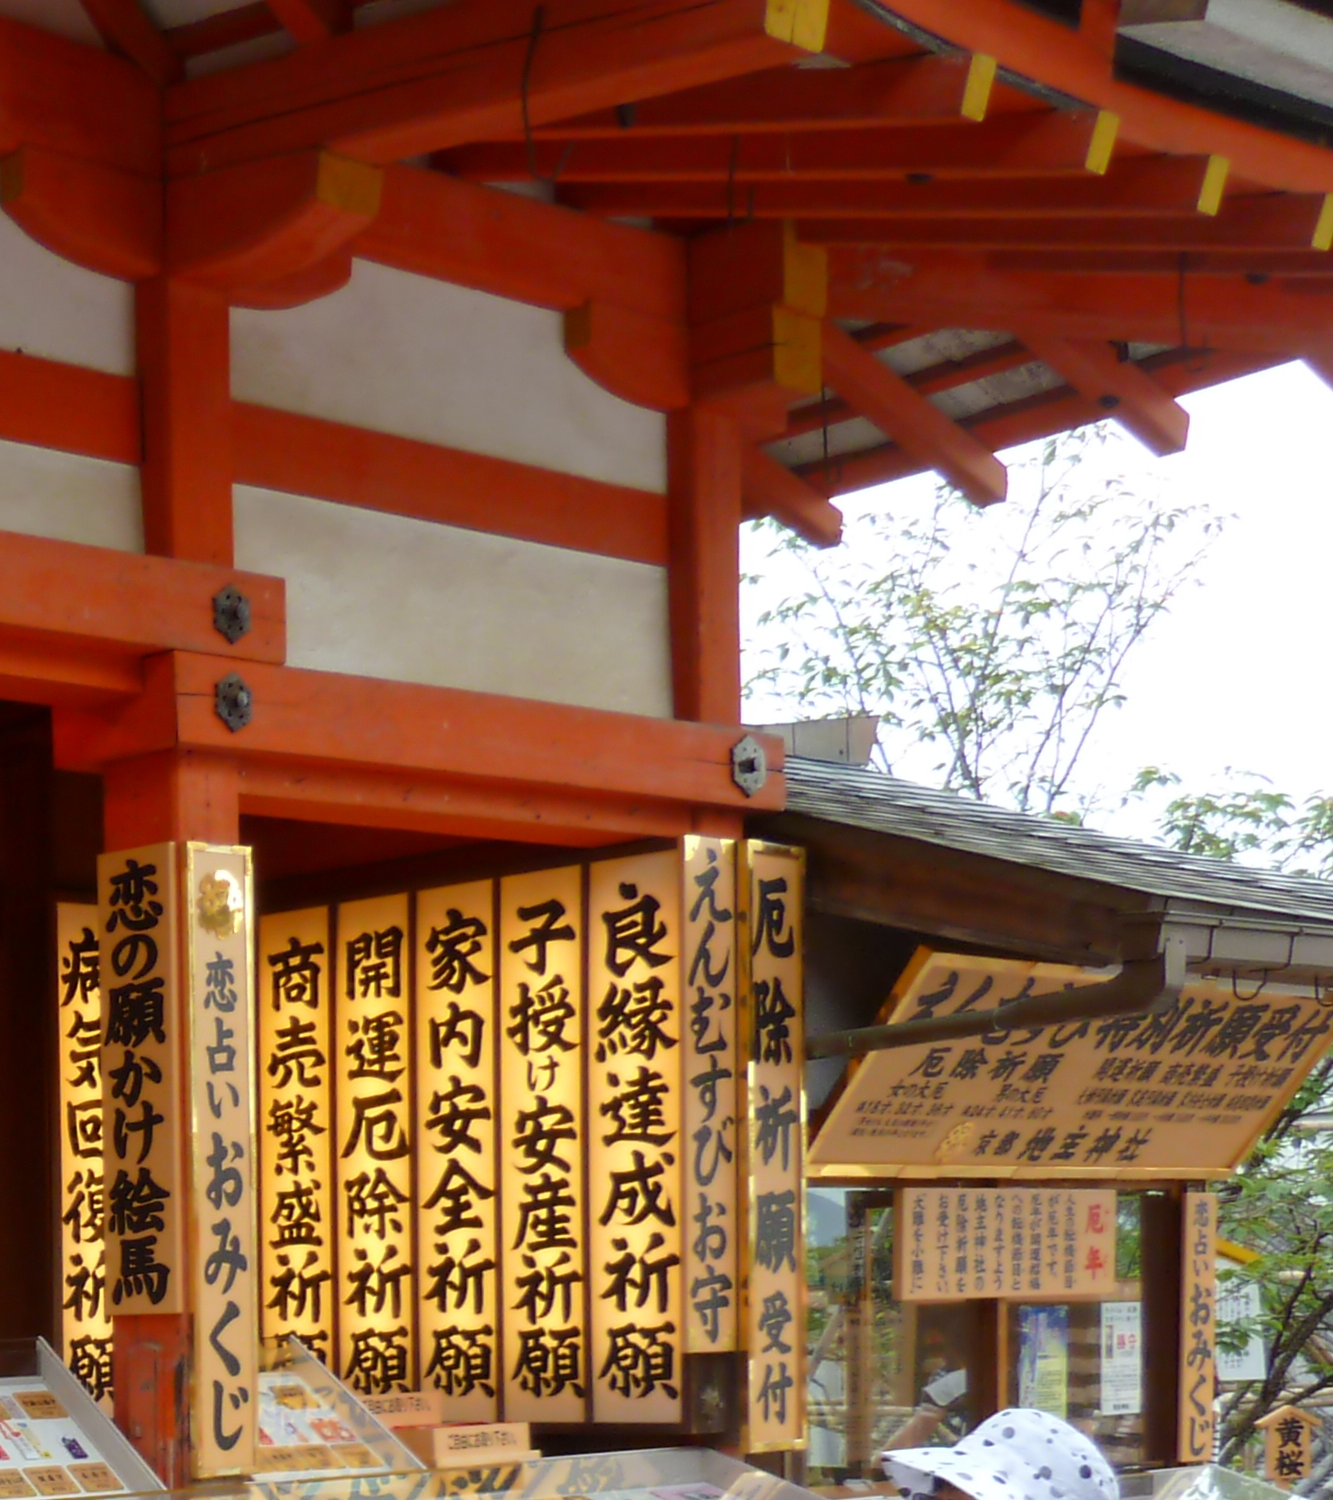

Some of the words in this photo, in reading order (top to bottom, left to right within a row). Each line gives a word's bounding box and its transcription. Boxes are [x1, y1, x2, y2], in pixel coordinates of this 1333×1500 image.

[104, 859, 171, 1307] 恋の願かけ絵馬
[203, 951, 250, 1452] 恋占いおみくじ
[340, 926, 413, 1396] 開運厄除祈願
[423, 907, 497, 1398] 家内安全祈願
[507, 899, 585, 1398] 子授け安産祈願
[594, 882, 682, 1398] 良縁達成祈願
[687, 847, 735, 1344] えんむすびお守
[751, 877, 797, 1425] 厄除祈願受付
[907, 1046, 1065, 1084] 厄除祈願
[973, 1129, 1021, 1157] 京都
[1018, 1125, 1154, 1163] 地主神社
[1085, 1203, 1104, 1281] 厄年
[1187, 1199, 1212, 1458] 恋占いおみくじ
[1274, 1417, 1305, 1477] 黄桜
